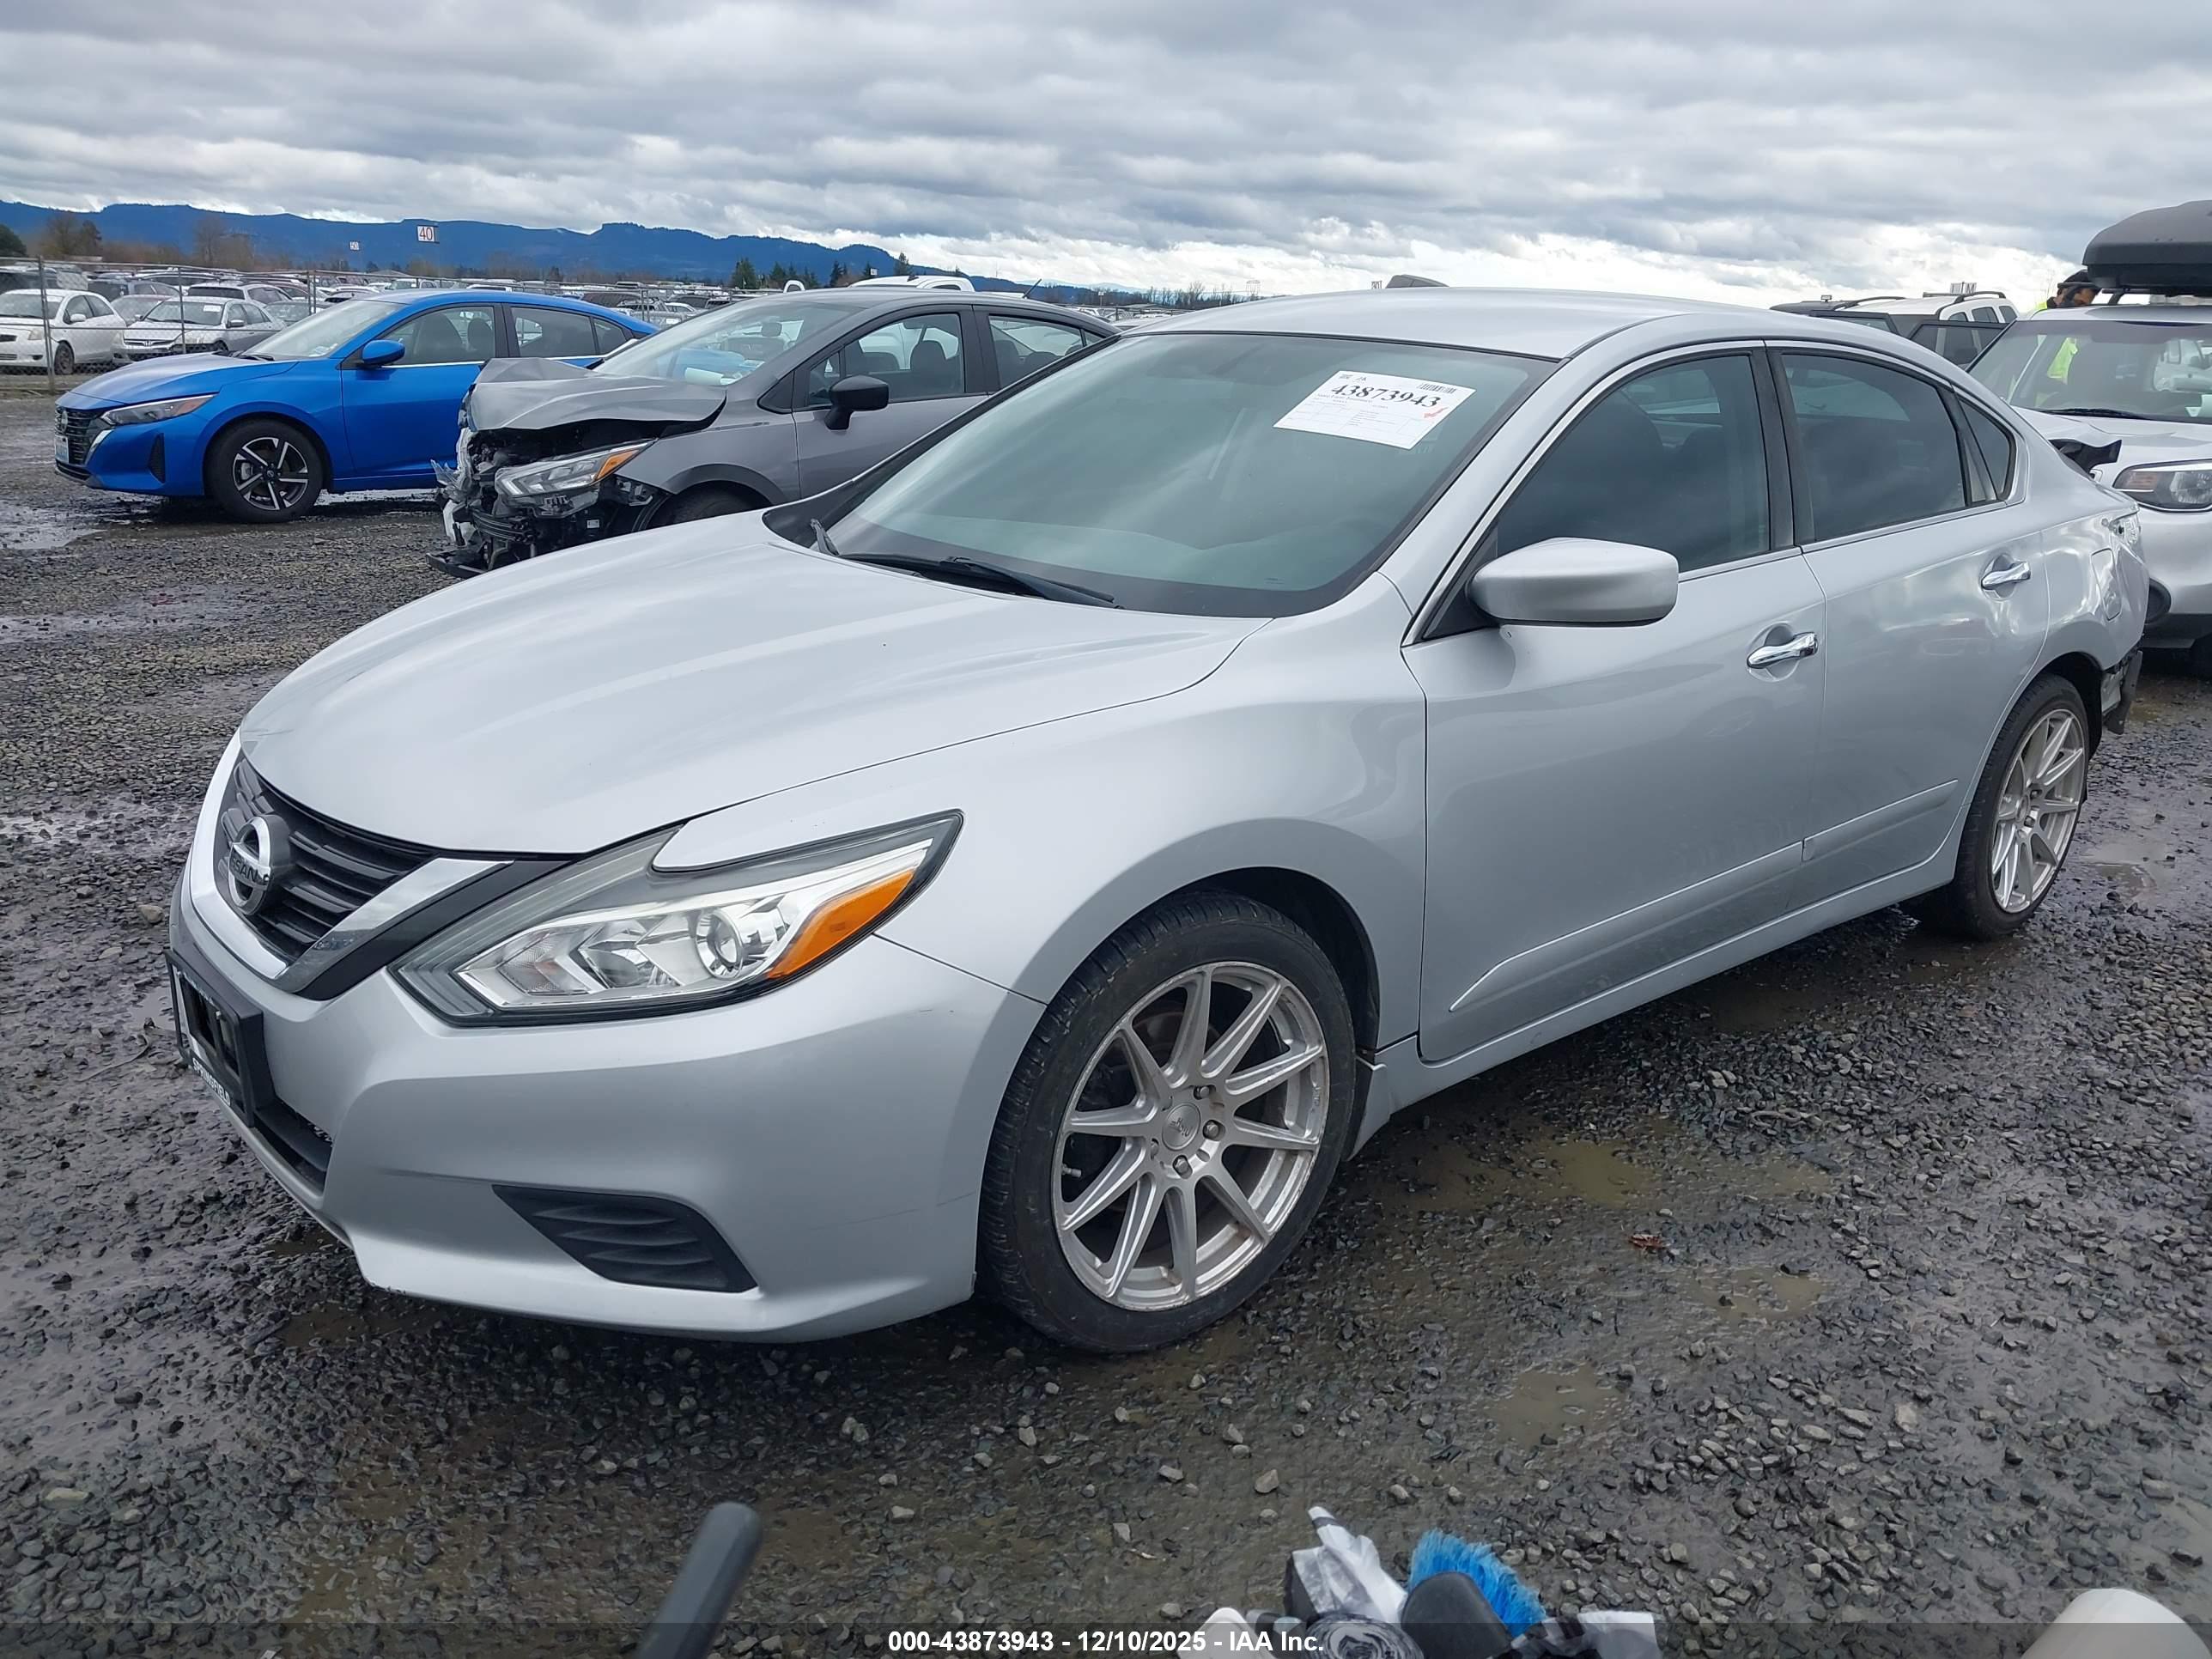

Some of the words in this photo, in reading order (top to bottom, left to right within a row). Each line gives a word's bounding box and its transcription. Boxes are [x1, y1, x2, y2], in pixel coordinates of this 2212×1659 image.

[419, 226, 434, 241] 40
[1331, 384, 1442, 407] 43873943
[192, 1057, 231, 1107] SPRINGFIELD
